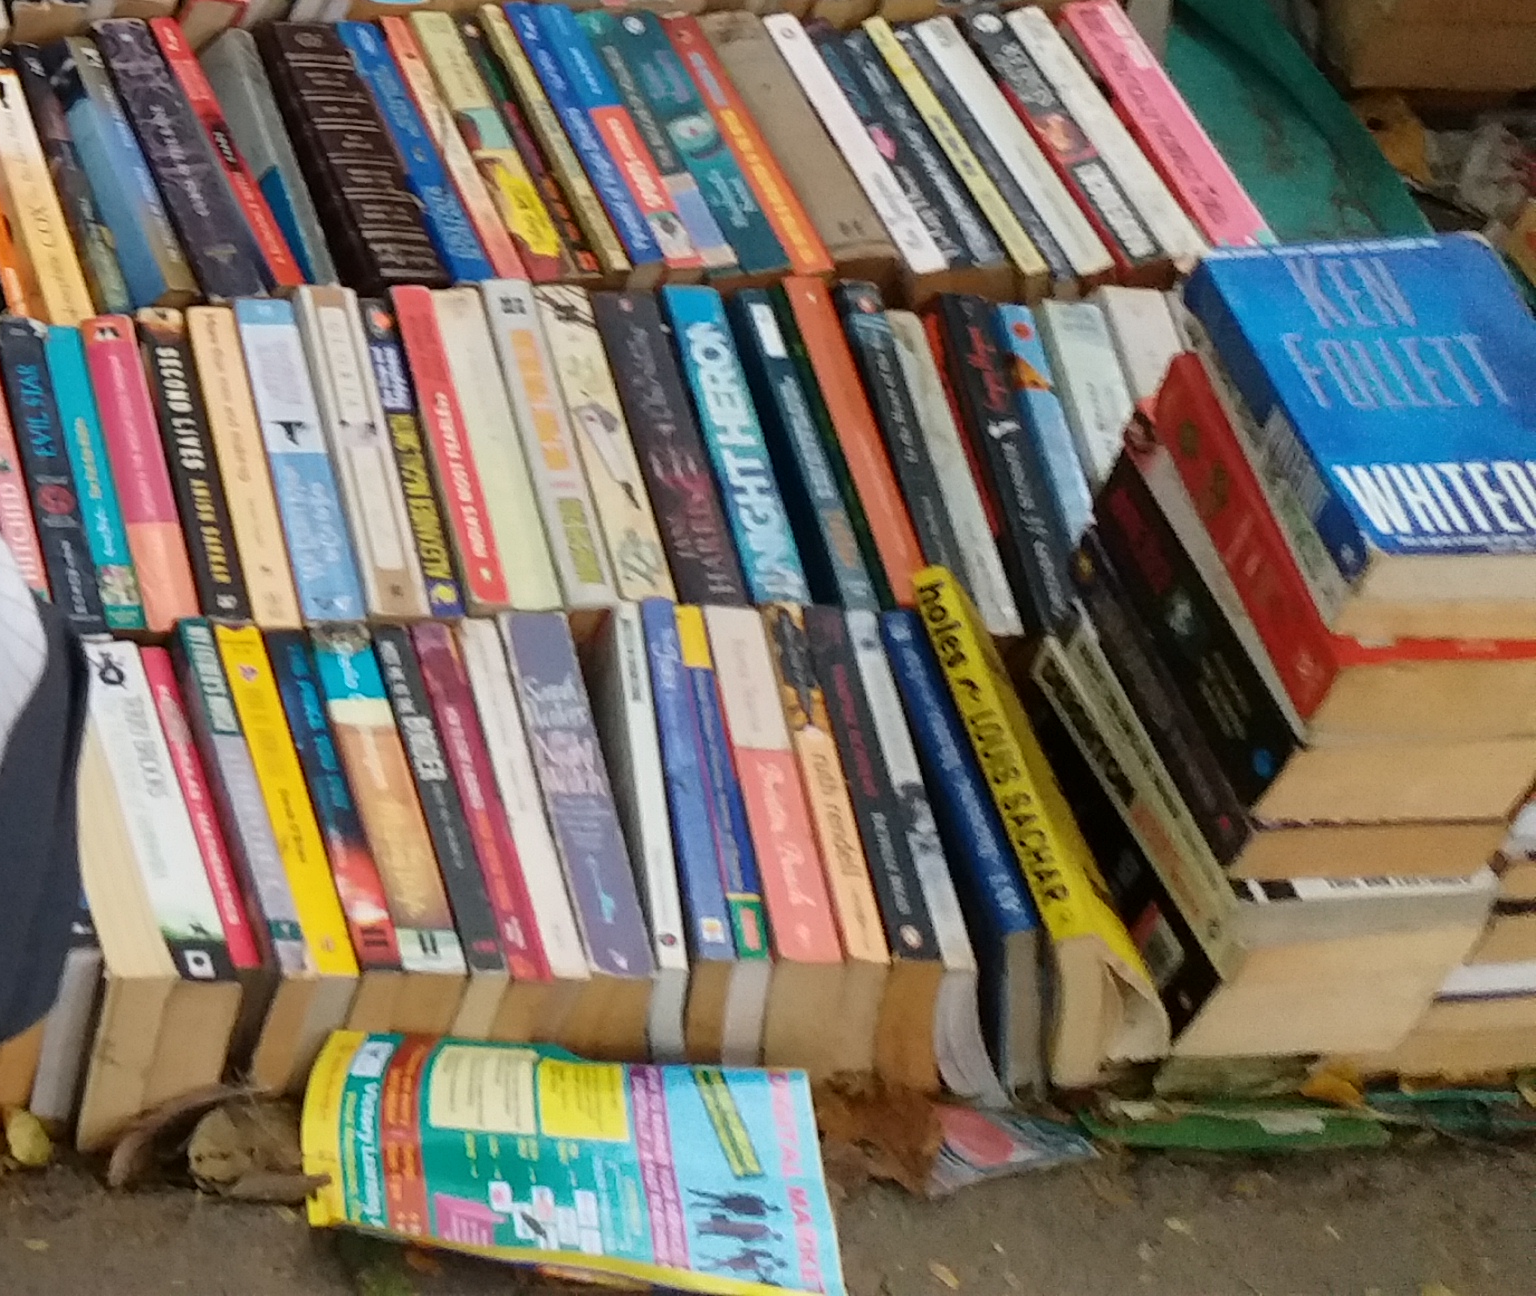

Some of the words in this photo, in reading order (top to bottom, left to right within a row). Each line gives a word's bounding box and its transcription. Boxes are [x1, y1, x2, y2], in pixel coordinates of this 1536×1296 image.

[1283, 256, 1418, 329] KEN
[15, 364, 42, 414] STAR
[155, 345, 193, 414] SECOND
[1280, 330, 1510, 409] FOLLETT
[26, 414, 58, 459] EVIL
[170, 413, 207, 472] LIVES
[916, 579, 966, 672] holes
[1002, 794, 1070, 906] SACHAR
[810, 752, 837, 805] ruth
[823, 806, 868, 884] rendell
